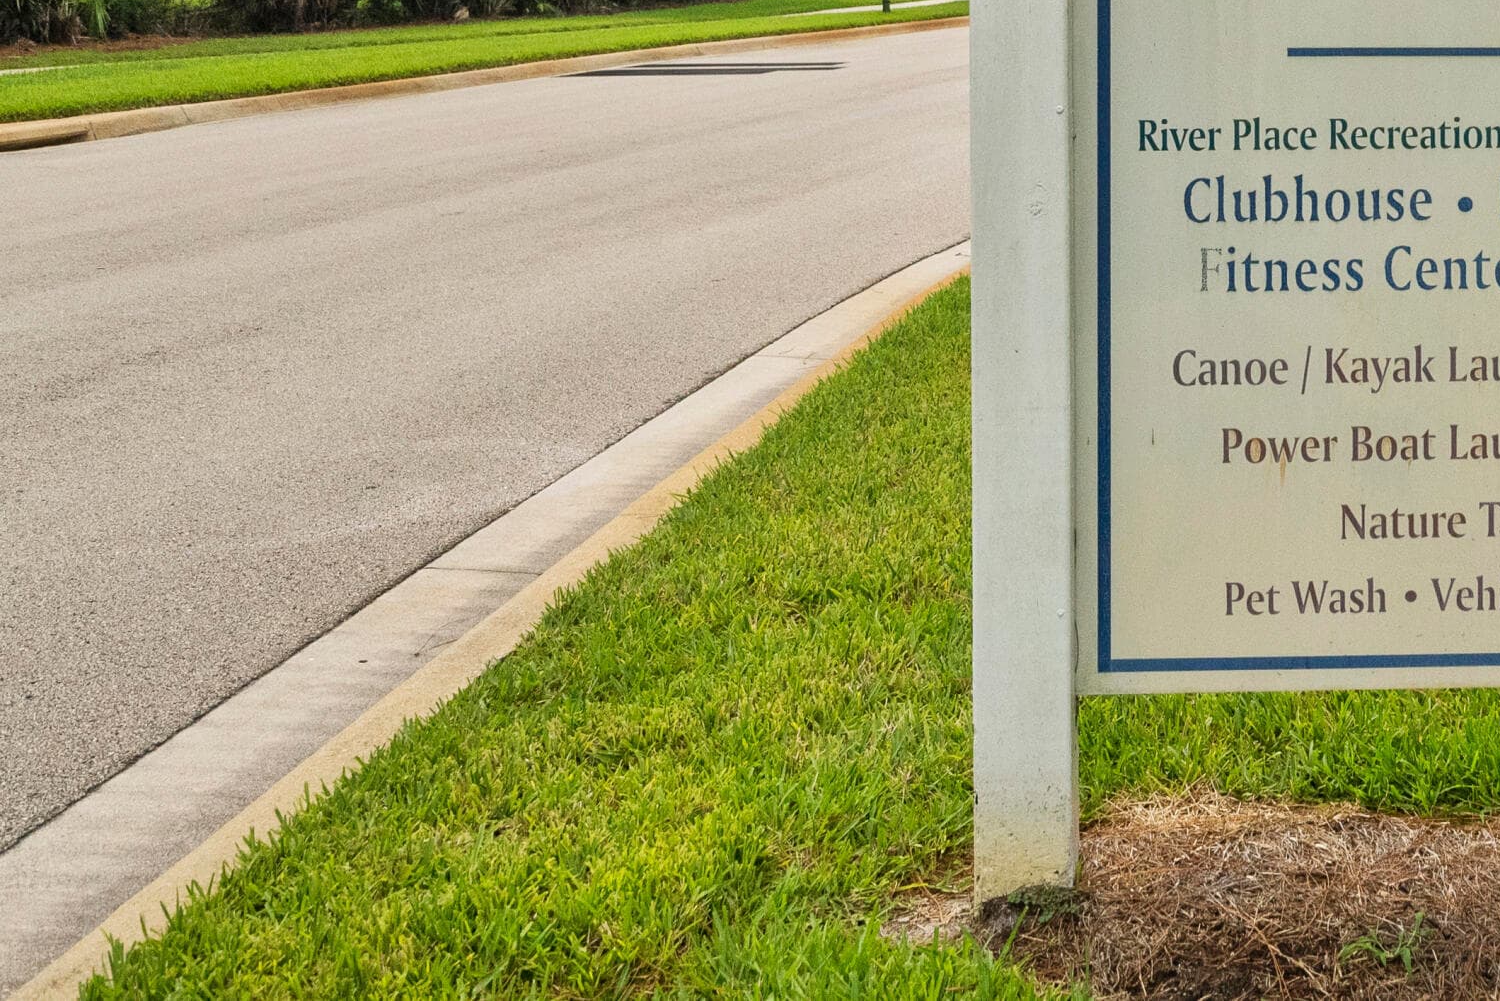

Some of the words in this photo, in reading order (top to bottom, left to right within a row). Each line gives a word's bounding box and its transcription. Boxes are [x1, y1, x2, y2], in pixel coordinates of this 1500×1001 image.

[1138, 118, 1222, 152] River
[1232, 116, 1318, 151] Place
[1183, 173, 1433, 224] Clubhouse
[1200, 245, 1364, 293] Fitness
[1172, 349, 1289, 387] Canoe
[1300, 345, 1312, 396] /
[1324, 343, 1436, 394] Kayak
[1221, 427, 1339, 464] Power
[1350, 425, 1437, 462] Boat
[1340, 503, 1467, 540] Nature
[1225, 581, 1281, 616] Pet
[1290, 576, 1387, 615] Wash
